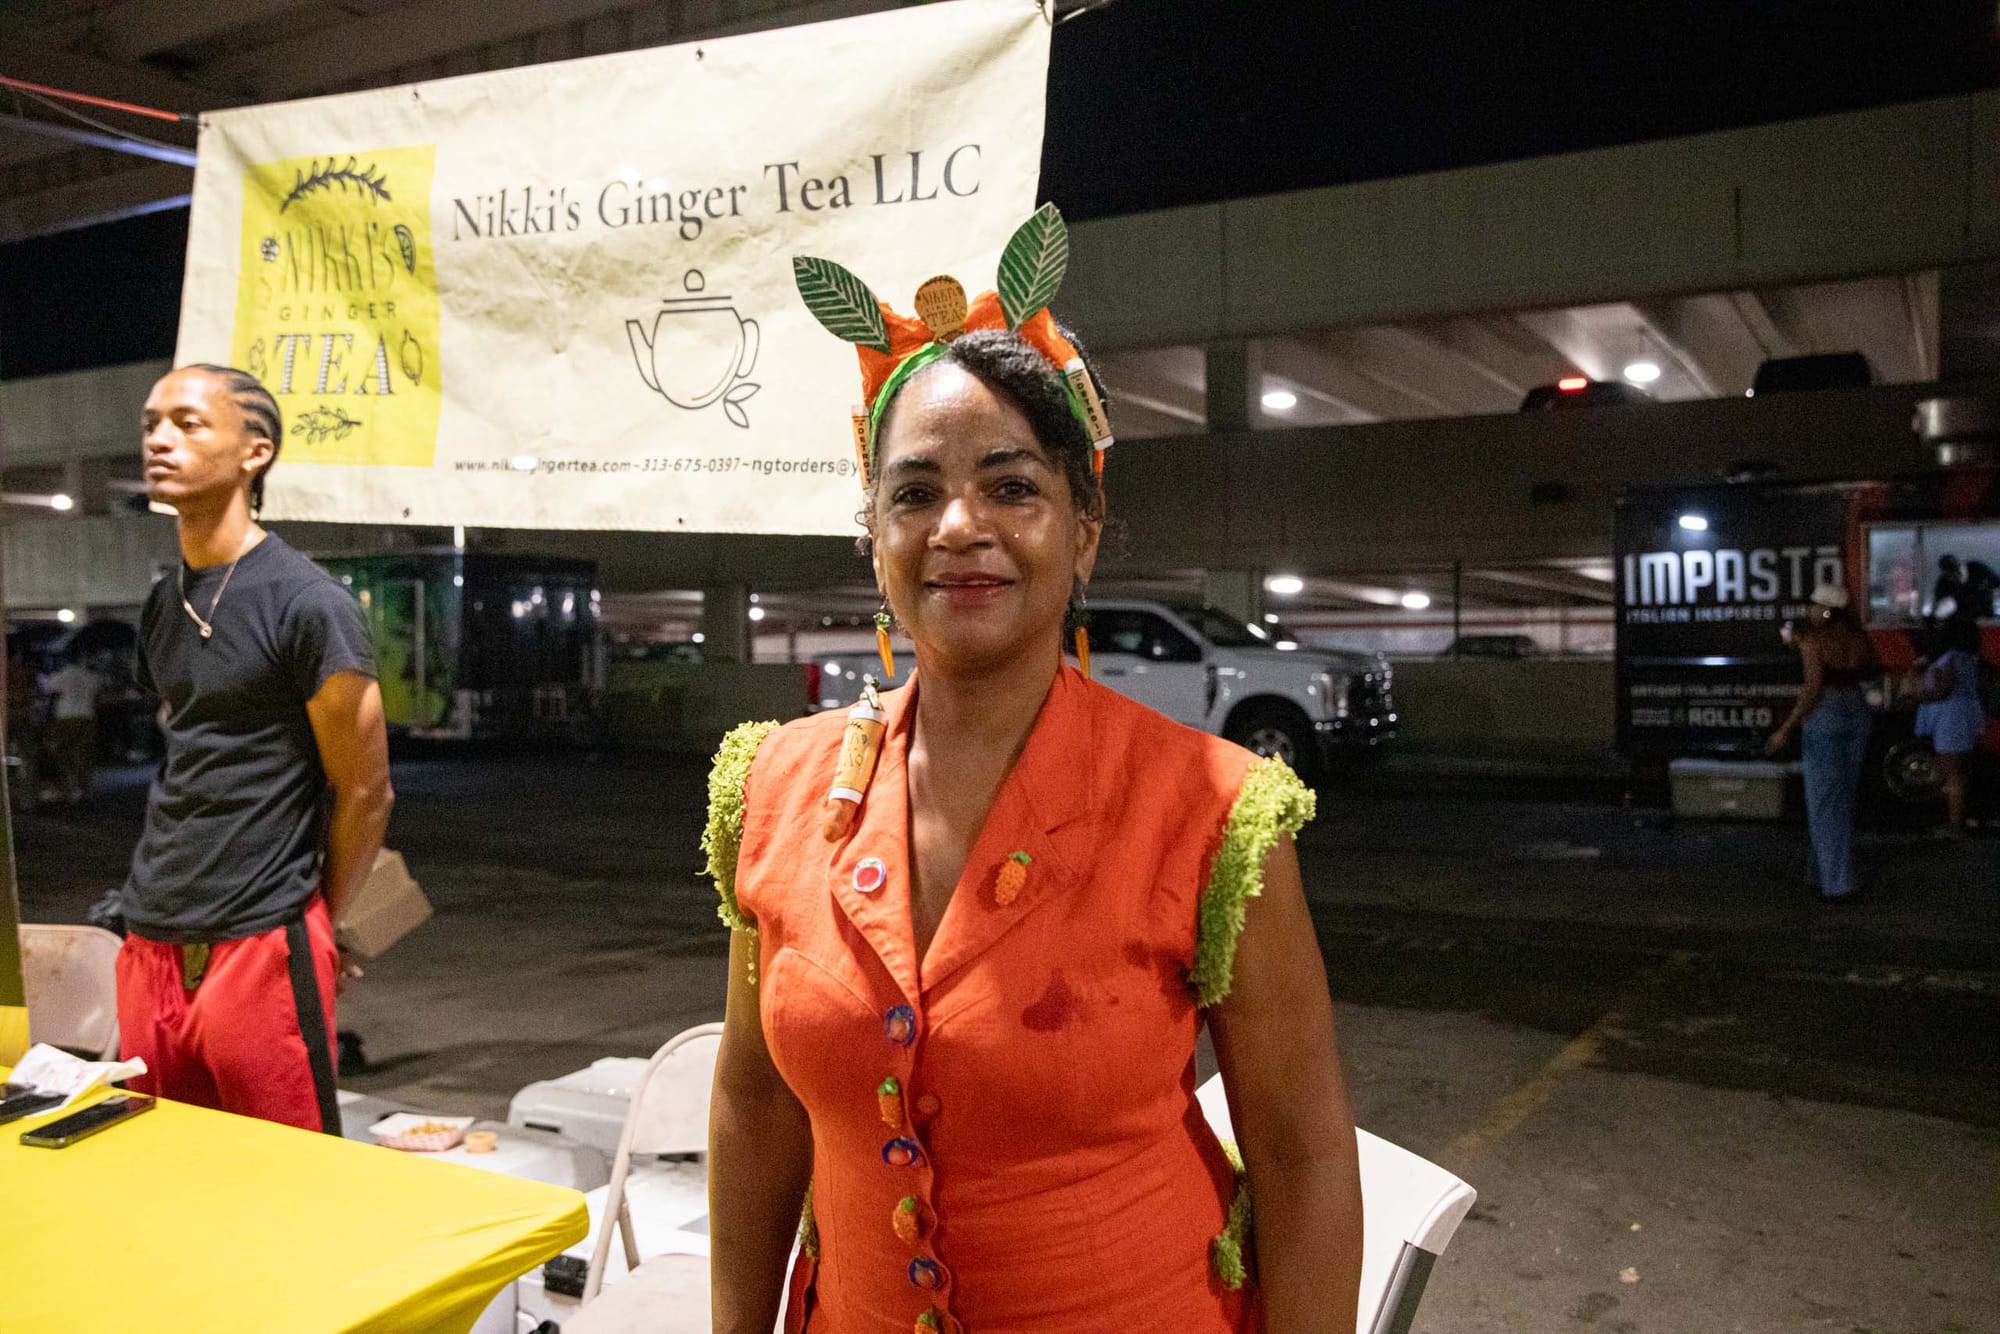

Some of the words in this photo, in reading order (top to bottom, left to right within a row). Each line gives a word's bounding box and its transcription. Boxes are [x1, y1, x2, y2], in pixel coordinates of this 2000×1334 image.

[453, 184, 580, 241] Nikki's
[598, 179, 747, 241] Ginger
[763, 160, 854, 214] Tea
[869, 143, 982, 206] LLC
[281, 222, 395, 292] NIKKI'S
[279, 301, 397, 321] GINGER
[273, 333, 396, 396] TEA
